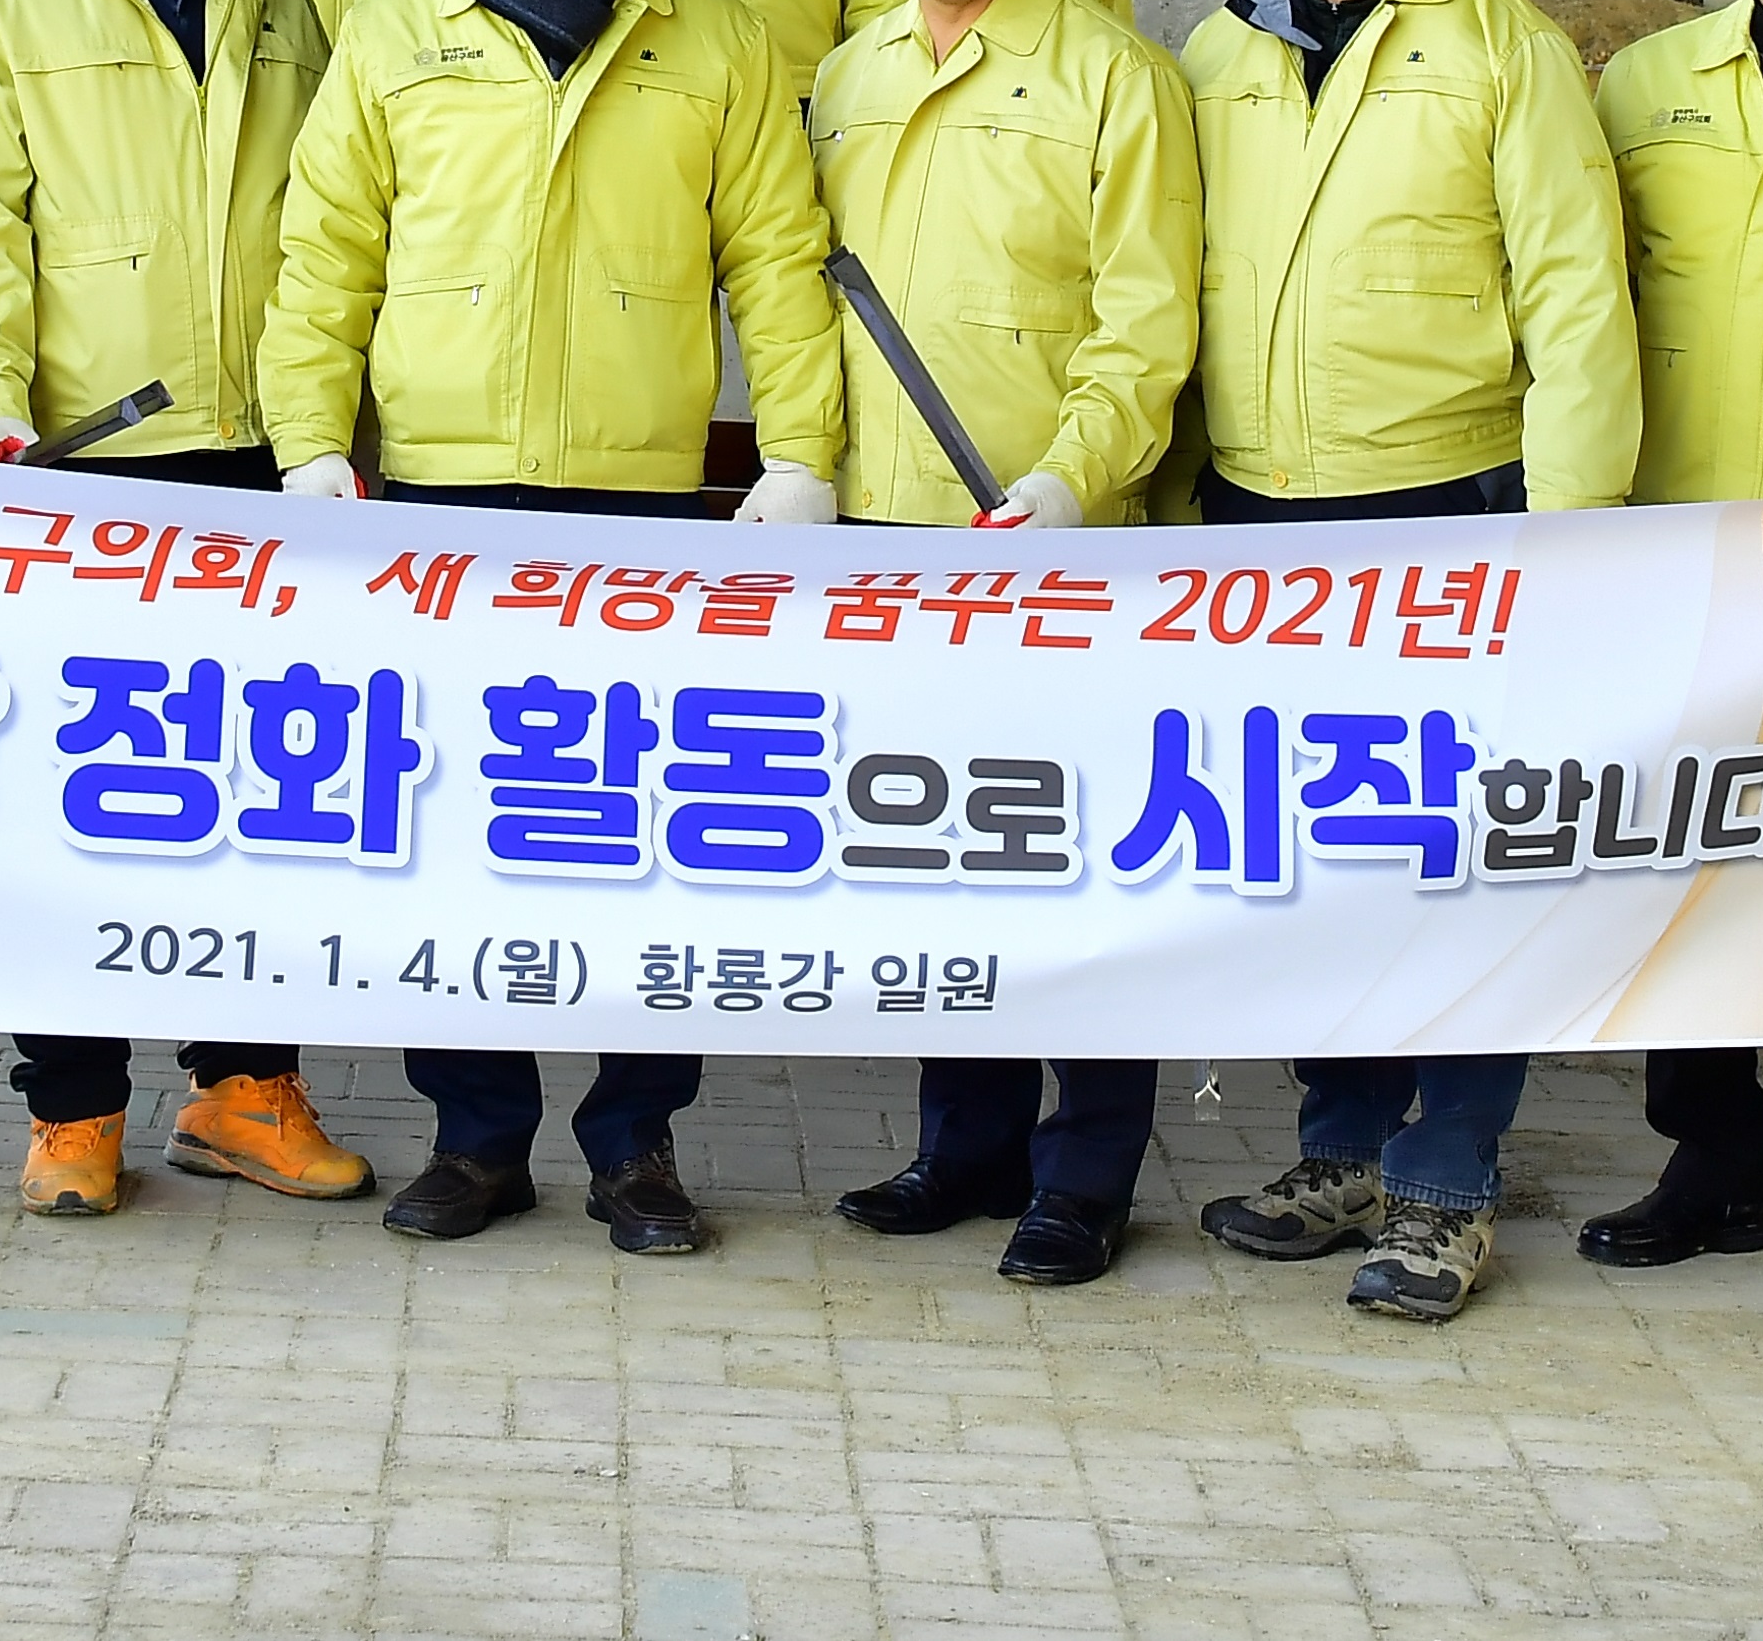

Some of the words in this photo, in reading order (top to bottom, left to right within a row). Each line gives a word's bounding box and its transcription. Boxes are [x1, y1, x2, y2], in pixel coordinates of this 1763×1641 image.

[368, 553, 478, 620] 새
[493, 565, 794, 637] 희망을
[824, 571, 1114, 650] 꿈꾸는
[1140, 562, 1521, 659] 2021년!
[56, 656, 421, 854] 정화
[480, 675, 1070, 874] 활동으로
[95, 921, 285, 984] 2021.
[320, 934, 369, 991] 1.
[398, 938, 588, 1006] 4.(월)
[636, 944, 845, 1013] 황룡강
[871, 952, 998, 1013] 일원
